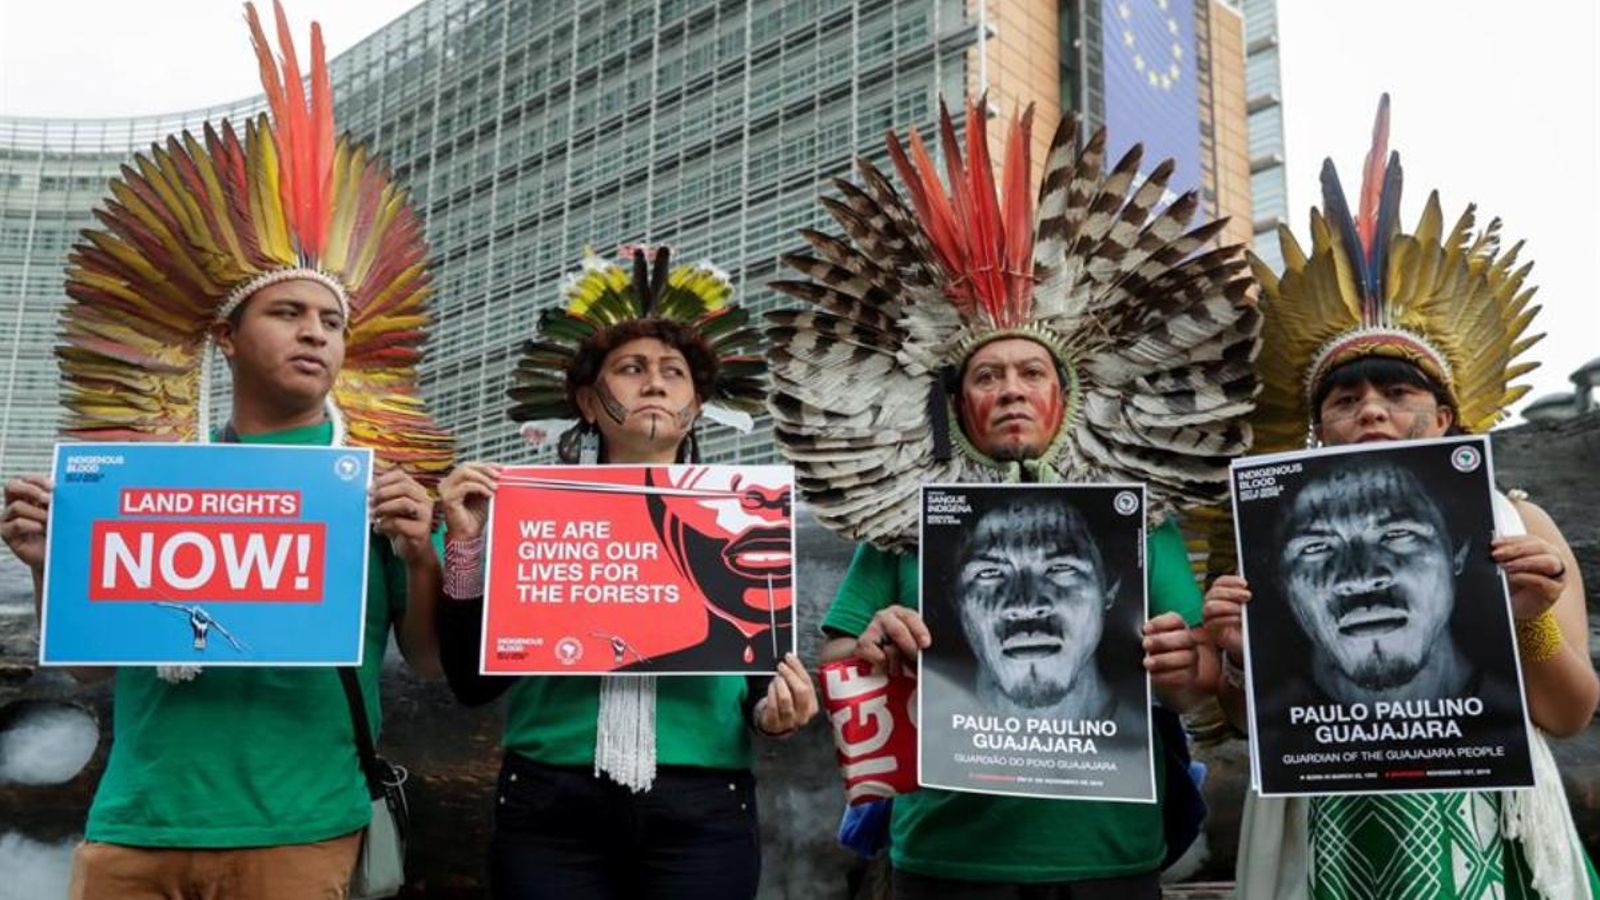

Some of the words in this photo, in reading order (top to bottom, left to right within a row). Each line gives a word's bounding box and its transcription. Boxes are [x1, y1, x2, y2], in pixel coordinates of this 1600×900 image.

[1237, 463, 1303, 479] INDIGENOUS
[1239, 477, 1276, 489] BLOOD
[123, 493, 193, 513] LAND
[201, 494, 296, 514] RIGHTS
[519, 521, 556, 538] WE
[562, 521, 611, 538] ARE
[518, 542, 599, 560] GIVING
[606, 542, 658, 560] OUR
[102, 531, 312, 591] NOW!
[518, 564, 583, 582] LIVES
[590, 564, 638, 581] FOR
[517, 585, 564, 603] THE
[570, 585, 680, 604] FORESTS
[1290, 704, 1369, 725] PAULO
[1375, 698, 1483, 719] PAULINO
[951, 714, 1020, 733] PAULO
[1027, 717, 1118, 737] PAULINO
[1315, 720, 1462, 744] GUAJAJARA
[972, 733, 1098, 755] GUAJAJARA
[1009, 757, 1024, 766] DO
[1026, 758, 1056, 769] POVO
[1057, 760, 1118, 772] GUAJAJARA
[1282, 753, 1341, 766] GUARDIAN
[1342, 752, 1359, 762] OF
[1361, 751, 1383, 762] THE
[1386, 748, 1455, 761] GUAJAJARA
[1457, 746, 1504, 758] PEOPLE
